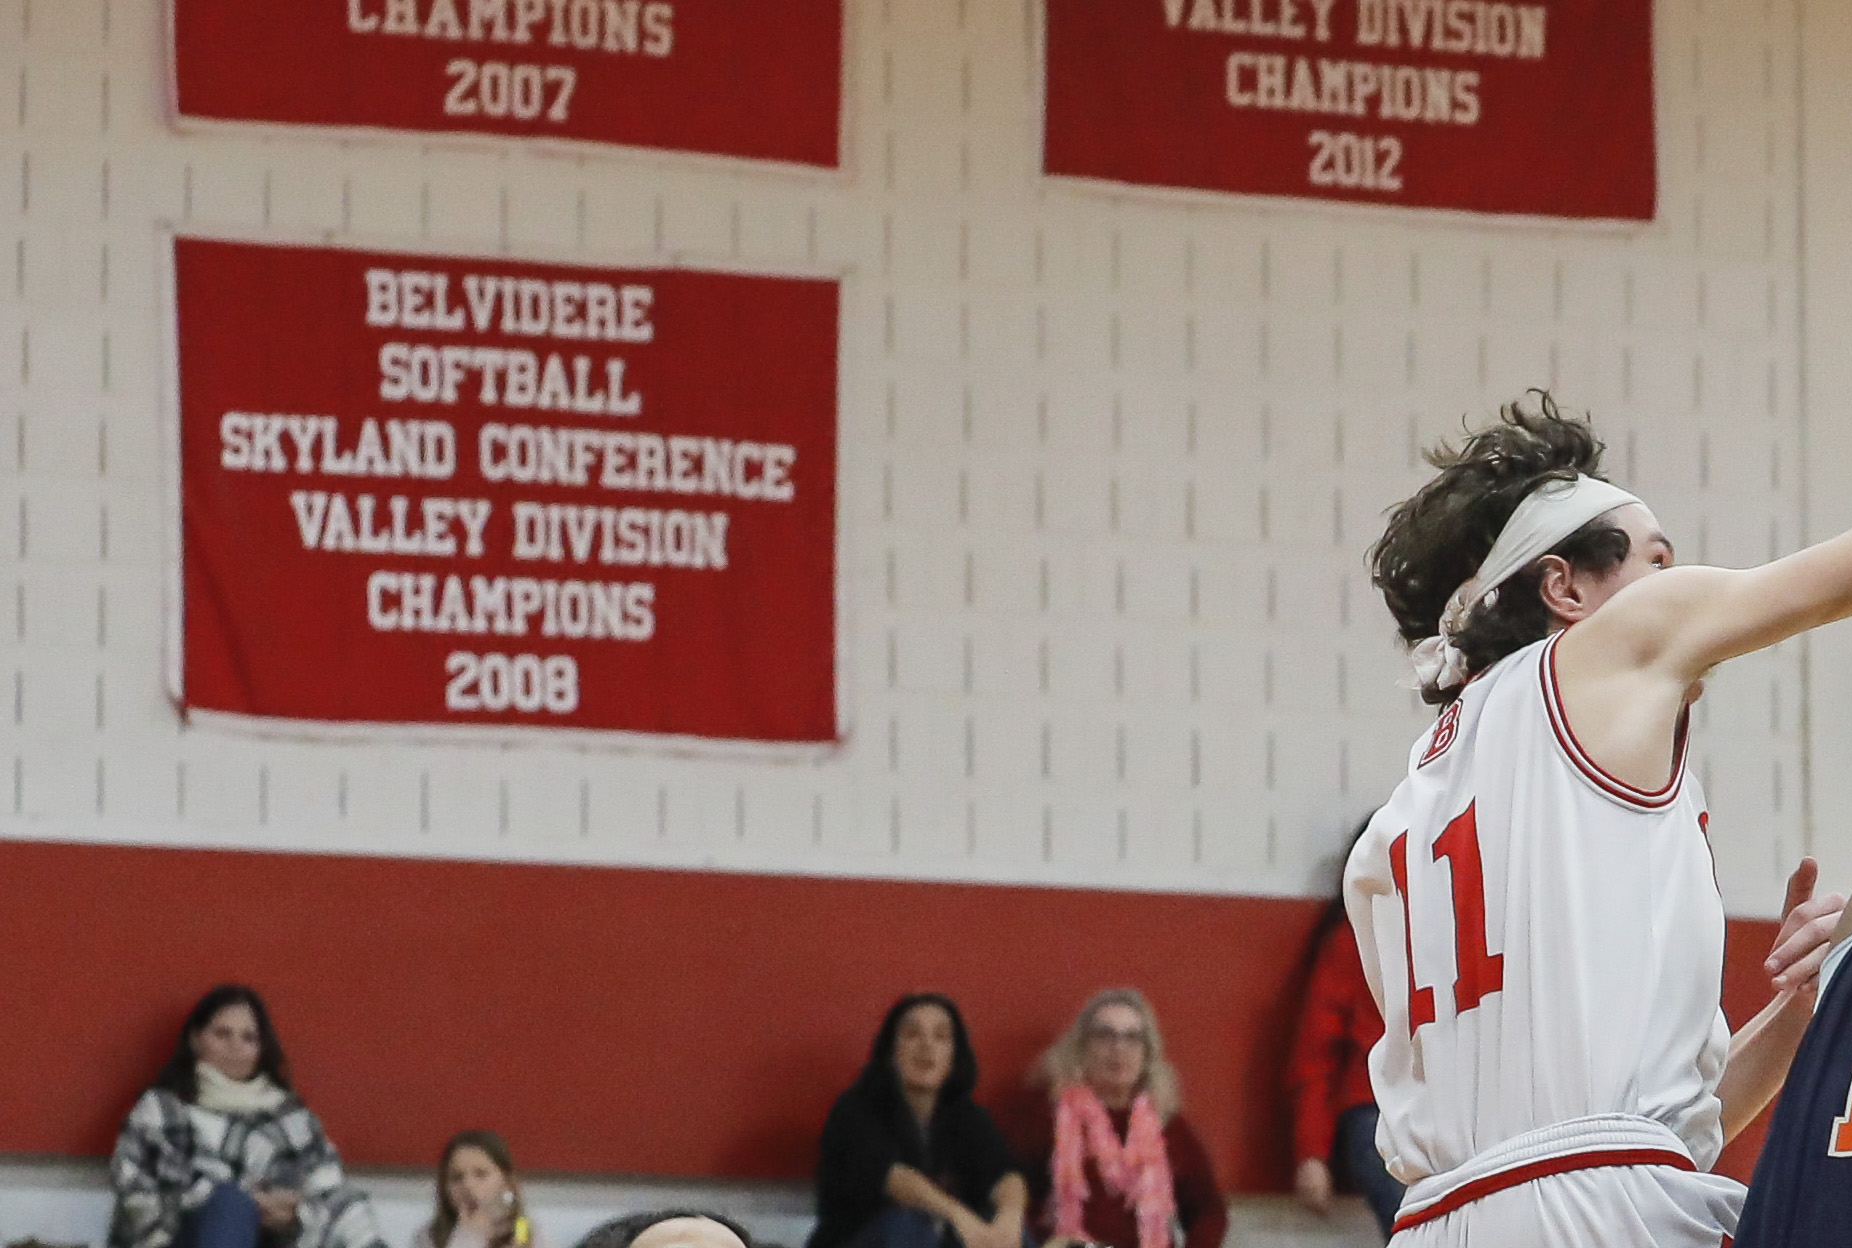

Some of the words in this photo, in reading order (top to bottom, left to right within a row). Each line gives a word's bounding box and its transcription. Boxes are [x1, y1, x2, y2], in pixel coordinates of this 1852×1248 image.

[1356, 0, 1547, 58] DIVISION
[443, 59, 576, 123] 2007
[1225, 52, 1481, 124] CHAMPIONS
[1308, 130, 1403, 191] 2012
[366, 268, 653, 343] BELVIDERE
[380, 344, 640, 415] SOFTBALL
[220, 411, 456, 479] SKYLAND
[479, 423, 796, 501] CONFERENCE
[291, 491, 491, 557] VALLEY
[511, 503, 729, 569] DIVISION
[366, 571, 656, 641] CHAMPIONS
[445, 652, 578, 713] 2008
[1388, 795, 1504, 1043] 11
